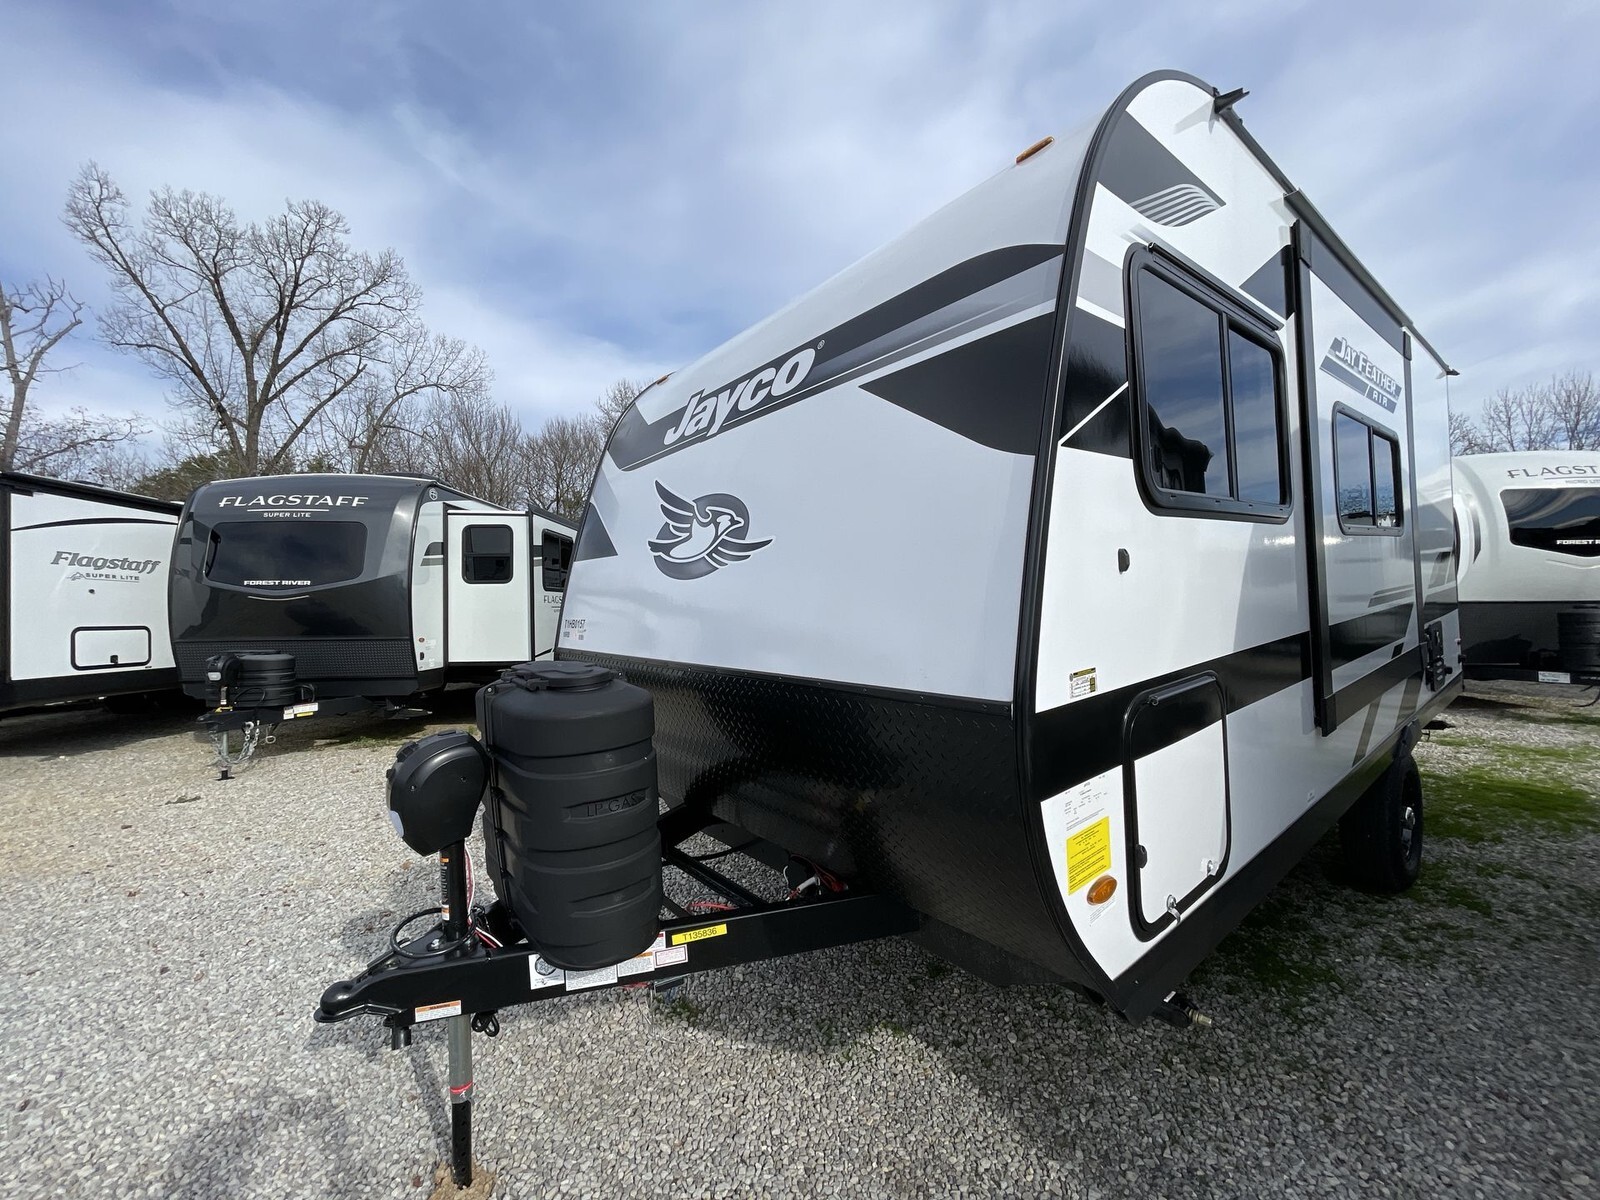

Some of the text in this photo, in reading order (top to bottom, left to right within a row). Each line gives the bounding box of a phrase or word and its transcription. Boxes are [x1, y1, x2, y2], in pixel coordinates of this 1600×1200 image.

[1335, 337, 1397, 396] JAY FEATHER
[664, 347, 816, 446] Jayco
[1372, 390, 1388, 407] AIR
[1506, 465, 1598, 479] FLAGST
[218, 494, 369, 508] FLAGSTAFF
[50, 550, 161, 575] Flagstaff
[85, 572, 117, 580] SUPER
[587, 793, 639, 817] LP GAS
[683, 927, 717, 942] T135836
